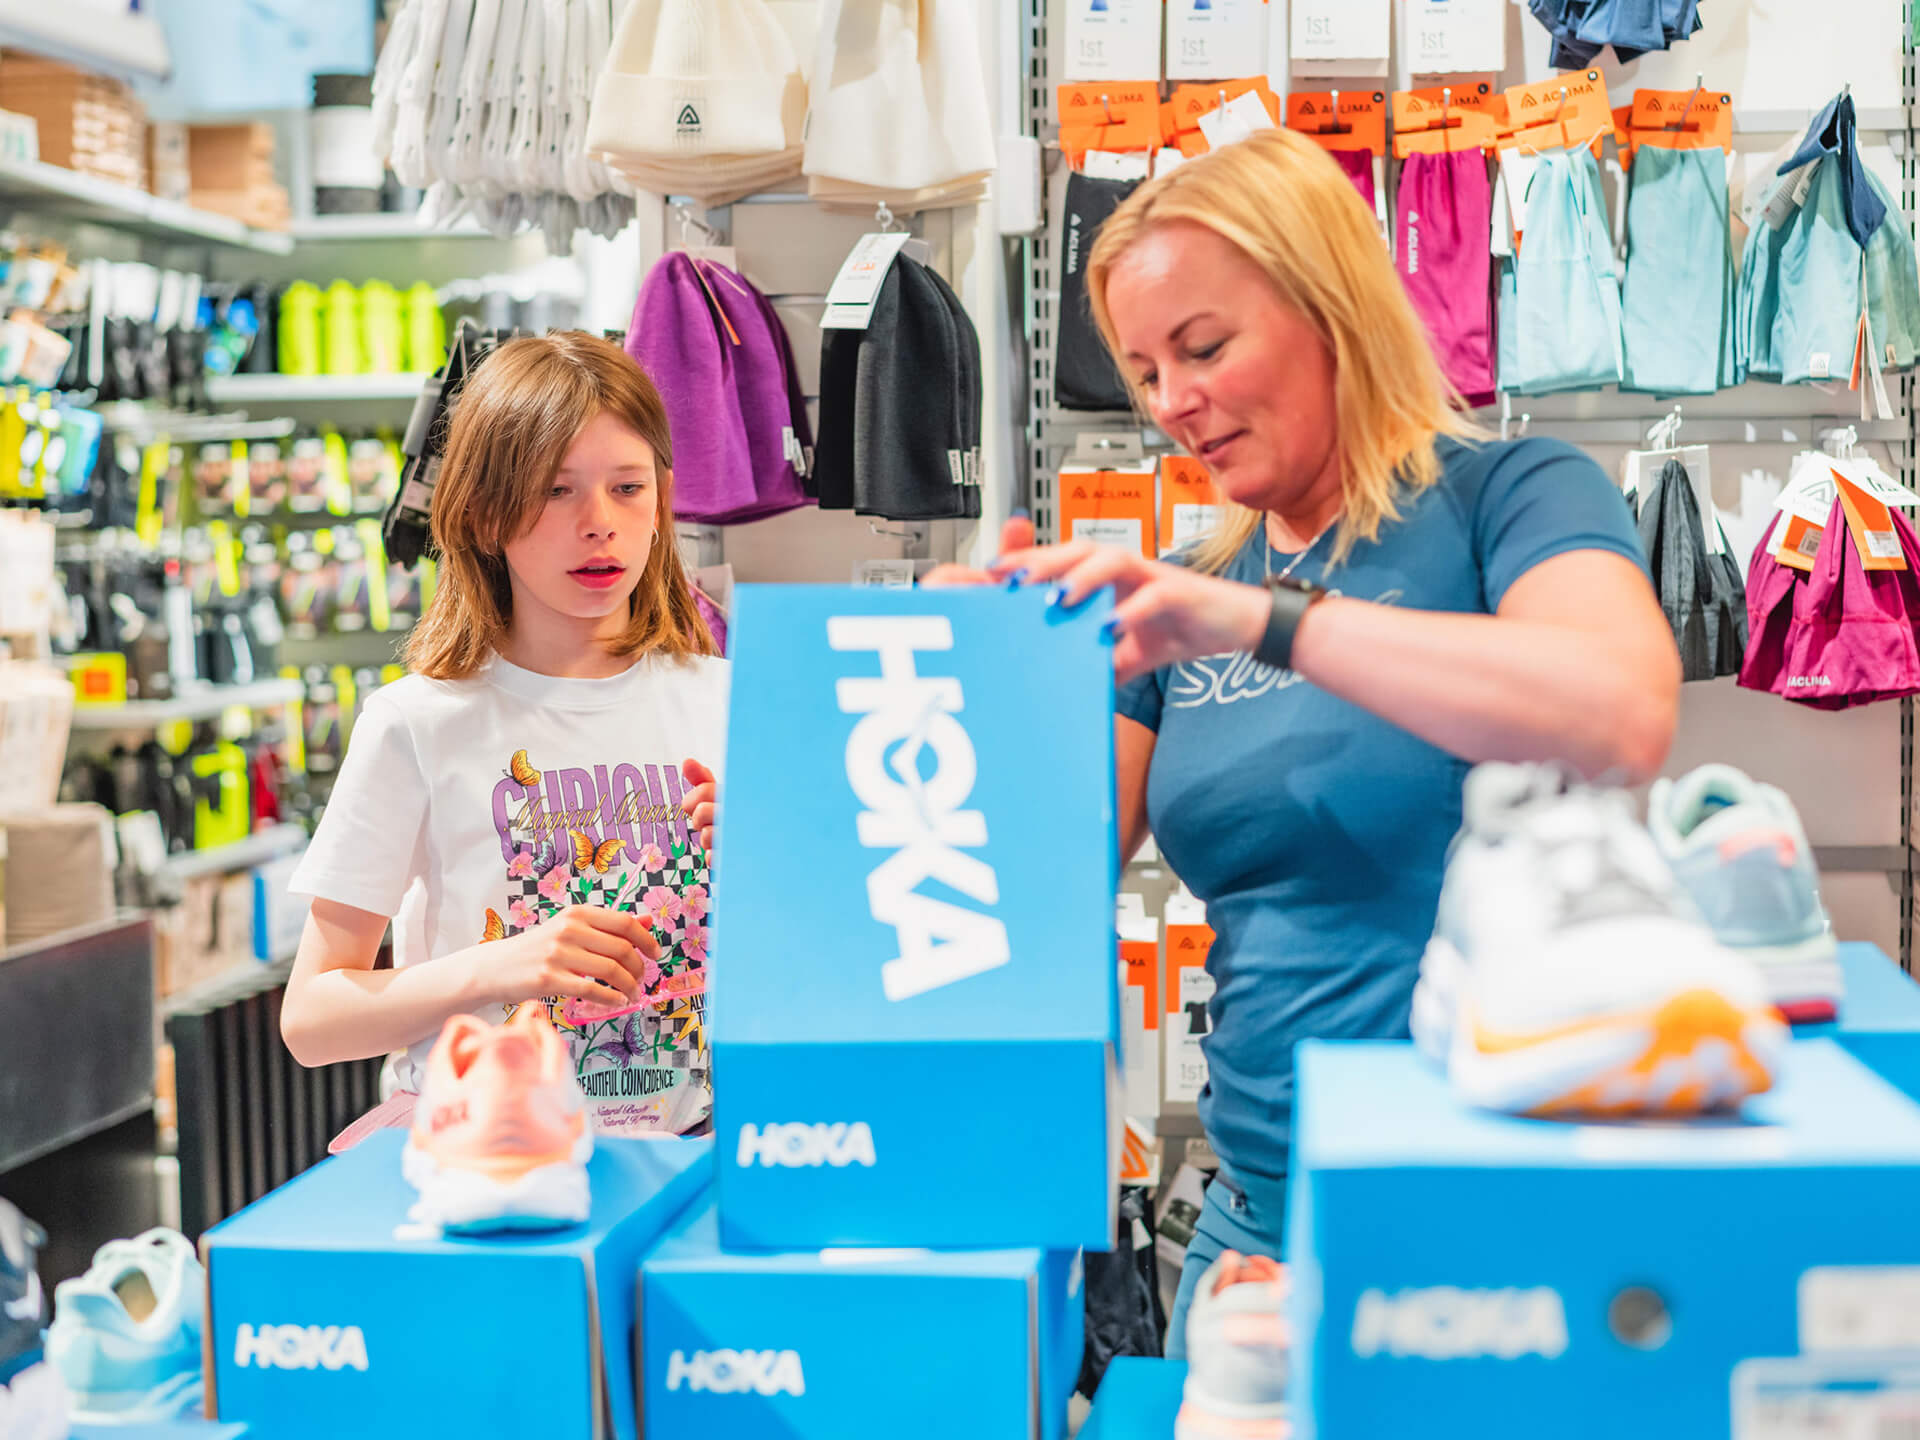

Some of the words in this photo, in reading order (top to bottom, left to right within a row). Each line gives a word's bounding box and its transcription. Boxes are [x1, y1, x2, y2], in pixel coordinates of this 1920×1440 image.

[1092, 93, 1145, 106] ALIMA
[1542, 83, 1595, 104] ACIMA
[492, 762, 703, 866] CURIOU
[826, 614, 1011, 1002] HOKA
[620, 1067, 675, 1097] COINCIDENCE
[736, 1121, 877, 1169] HOKA
[234, 1323, 369, 1372] HOKA
[665, 1348, 806, 1398] HOKA
